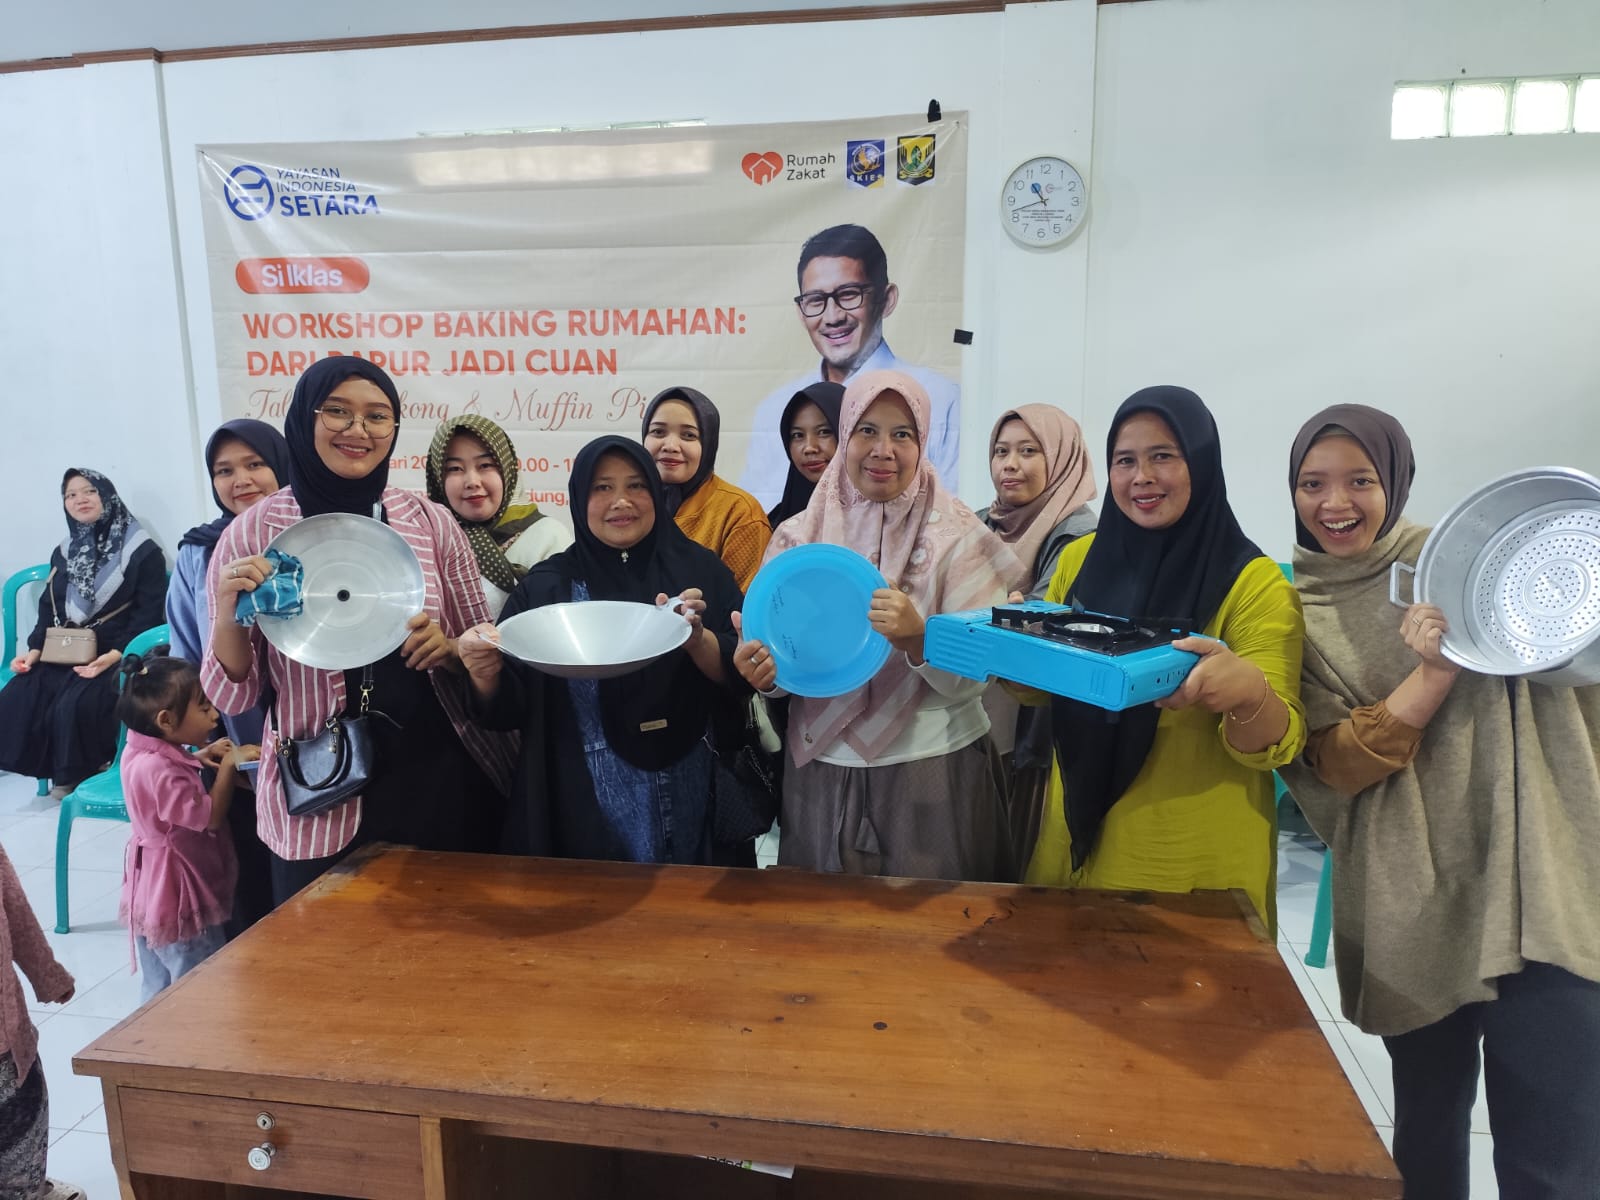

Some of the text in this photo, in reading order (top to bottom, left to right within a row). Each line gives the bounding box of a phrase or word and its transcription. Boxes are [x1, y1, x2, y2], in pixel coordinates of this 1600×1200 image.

[786, 152, 836, 167] Rumah
[276, 167, 341, 180] YAYASAN
[786, 167, 826, 181] Zakat
[1026, 168, 1034, 179] 11
[1040, 163, 1052, 175] 12
[1060, 169, 1064, 180] 1
[276, 181, 357, 193] INDONESIA
[1013, 179, 1025, 191] 10
[1067, 180, 1077, 192] 2
[279, 194, 380, 217] SETARA
[1007, 195, 1016, 206] 9
[1071, 196, 1080, 207] 3
[1011, 212, 1020, 223] 8
[1065, 213, 1073, 224] 4
[1022, 223, 1029, 233] 7
[1036, 228, 1046, 238] 6
[1053, 223, 1062, 234] 5
[261, 265, 284, 287] Si
[242, 307, 747, 339] WORKSHOP BAKING RUMAHAN:
[327, 350, 431, 377] PUR
[443, 349, 515, 377] JADI
[525, 348, 618, 376] CUAN
[496, 387, 594, 431] Muffin
